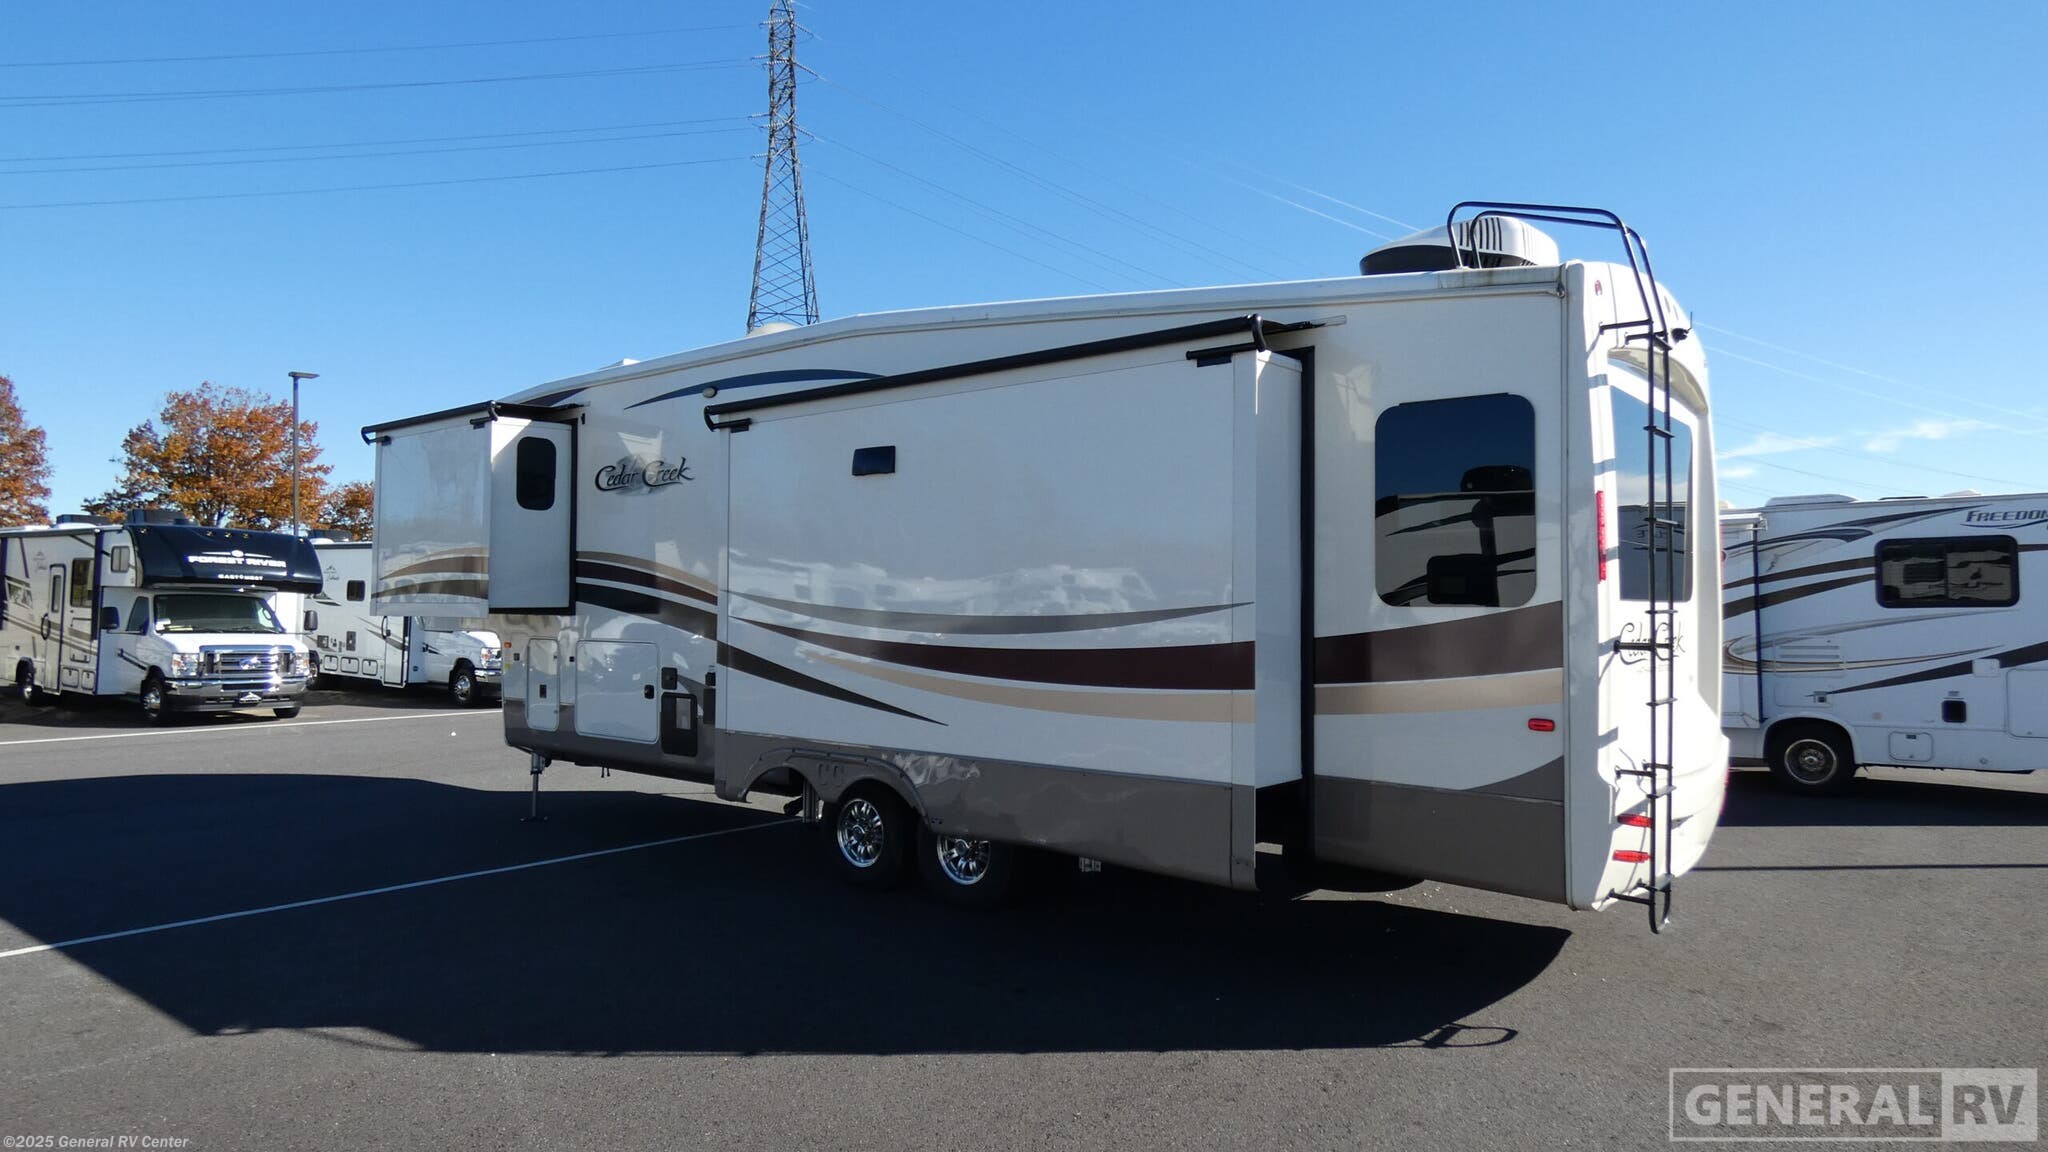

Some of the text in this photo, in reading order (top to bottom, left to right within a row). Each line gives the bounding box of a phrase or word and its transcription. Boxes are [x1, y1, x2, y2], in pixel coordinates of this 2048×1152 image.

[595, 456, 696, 492] Cedar Creek
[187, 555, 287, 568] FOREST RIVER
